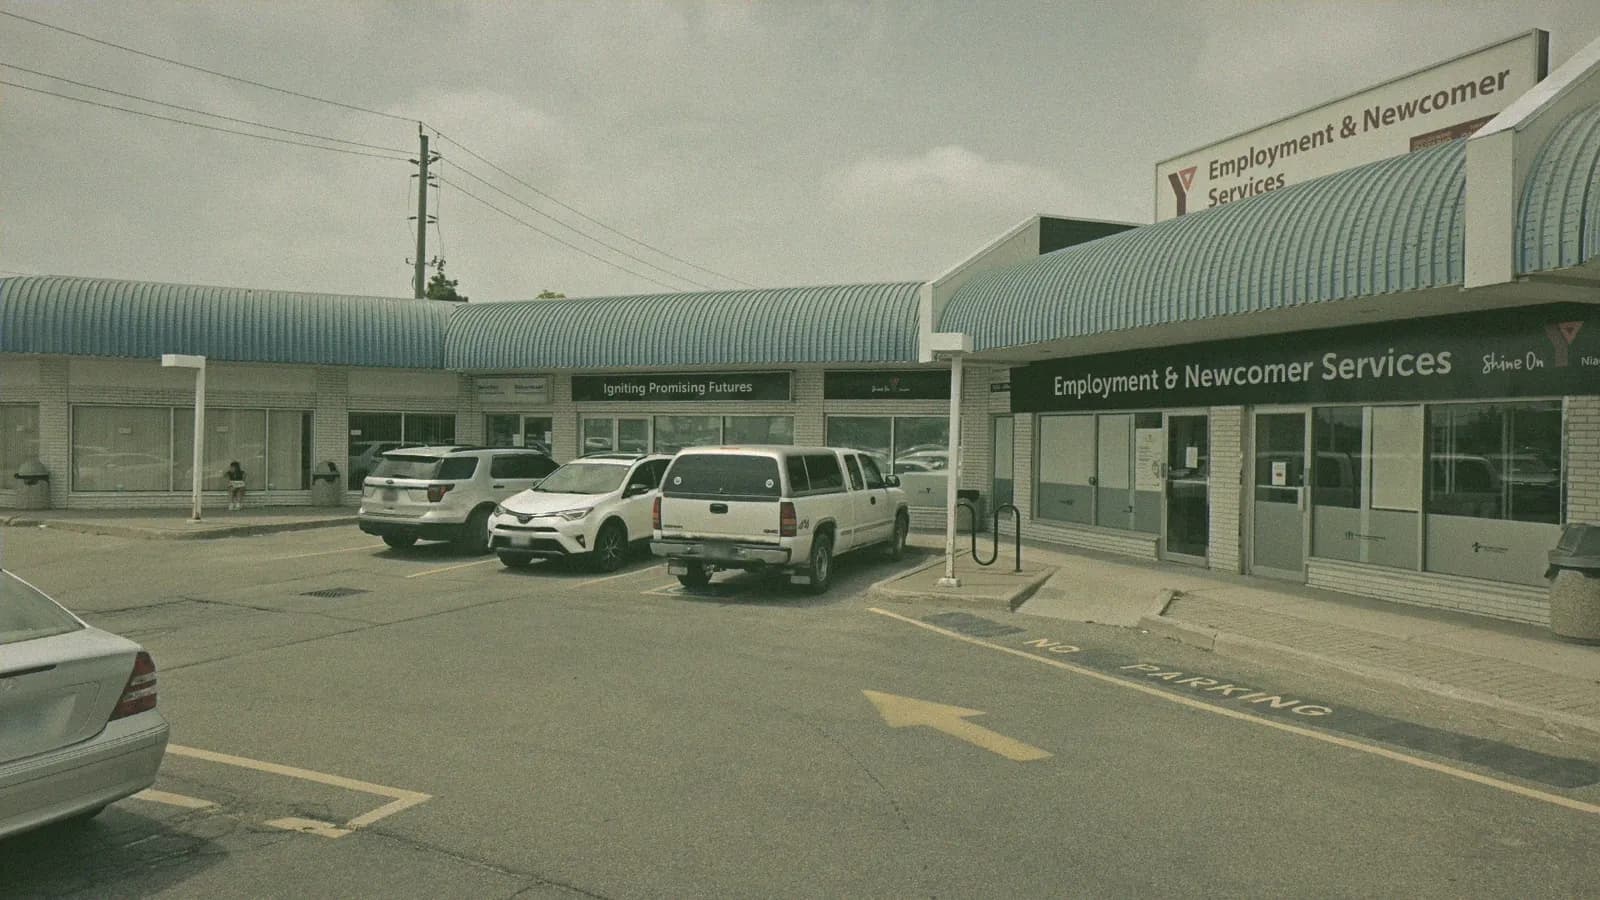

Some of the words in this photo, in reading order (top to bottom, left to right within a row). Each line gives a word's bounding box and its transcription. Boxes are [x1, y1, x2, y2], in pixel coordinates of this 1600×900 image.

[1208, 123, 1334, 181] Employment
[1340, 115, 1357, 139] &
[1363, 69, 1511, 132] Newcomer
[1208, 172, 1286, 208] Services
[1054, 368, 1160, 400] Employment
[1165, 366, 1179, 390] &
[1185, 360, 1314, 389] Newcomer
[1321, 348, 1453, 381] Services
[1482, 351, 1523, 375] Shine
[1526, 351, 1545, 371] On
[1581, 355, 1600, 368] Nia
[603, 382, 646, 397] Igniting
[649, 381, 706, 396] Promising
[709, 381, 753, 393] Futures
[1023, 638, 1081, 654] NO
[1120, 662, 1334, 717] PARKING
